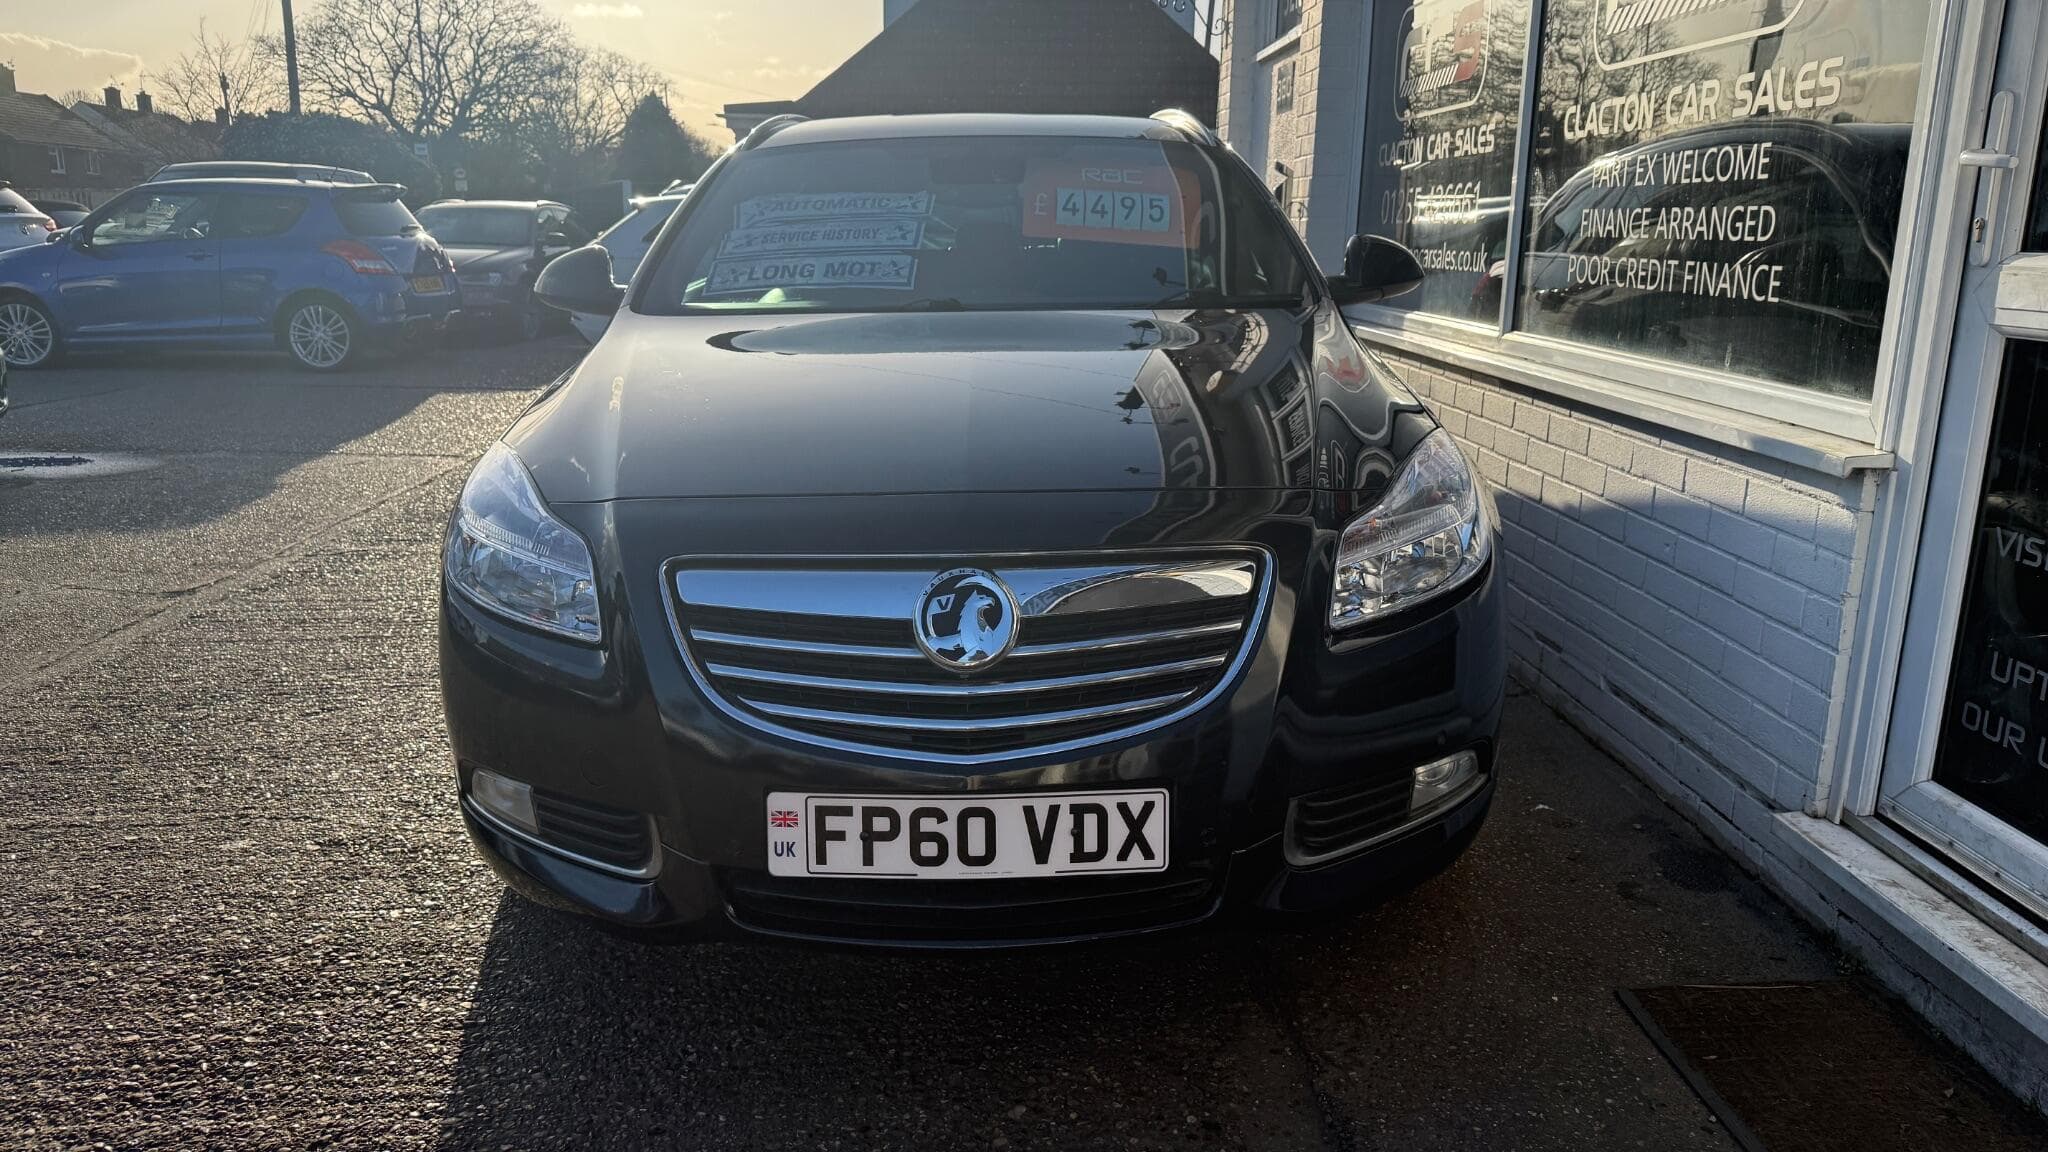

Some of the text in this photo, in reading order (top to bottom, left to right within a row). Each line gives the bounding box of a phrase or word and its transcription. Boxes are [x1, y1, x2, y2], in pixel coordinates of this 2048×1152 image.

[1563, 56, 1844, 140] CLACTON CAR SALES
[1379, 123, 1495, 166] CLACTON CAR SALES
[1592, 142, 1772, 188] PART EX WELCOME
[769, 196, 891, 212] AUTOMATIC
[1061, 192, 1165, 223] 4495
[761, 228, 879, 244] SERVICE HISTORY
[1581, 206, 1776, 242] FINANCE ARRANGED
[747, 262, 883, 281] LONG MOT
[1567, 255, 1784, 303] POOR CREDIT FINANCE
[1961, 701, 2026, 755] OUR
[774, 841, 796, 857] UK
[815, 801, 1155, 867] FP60 VDX
